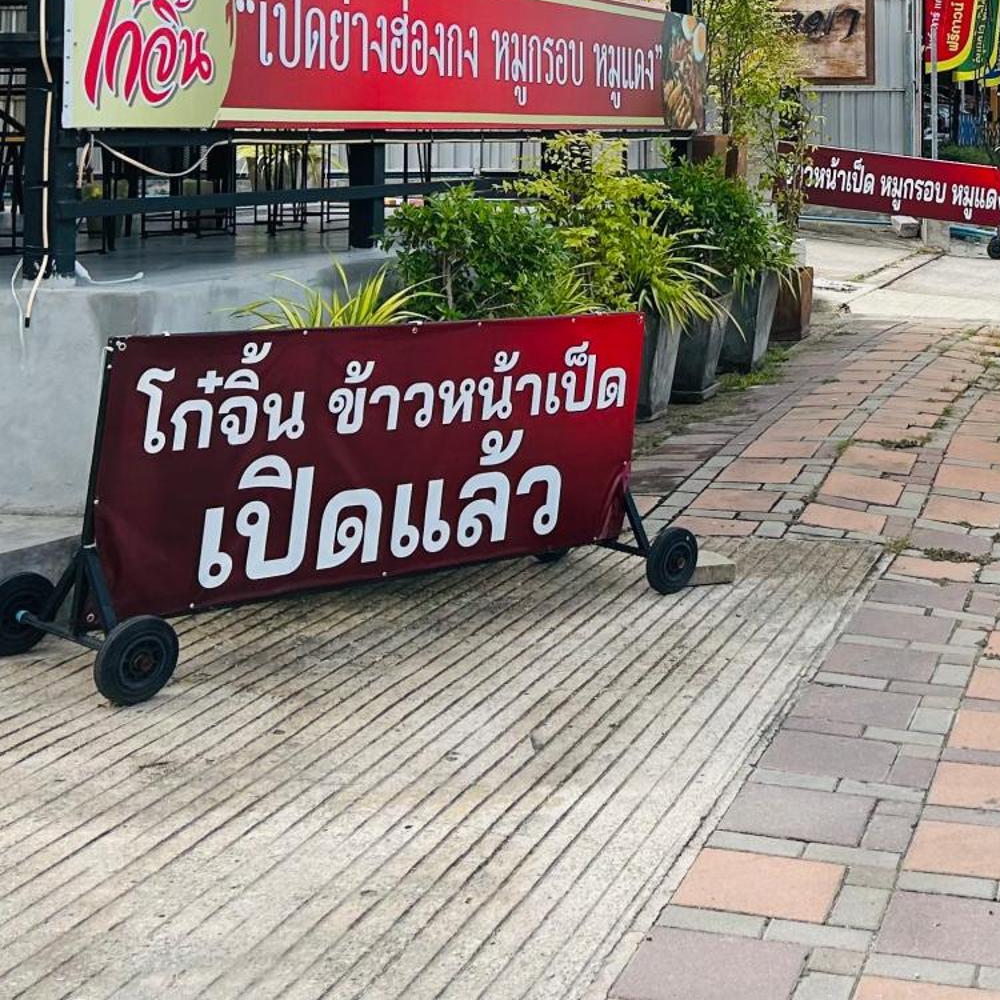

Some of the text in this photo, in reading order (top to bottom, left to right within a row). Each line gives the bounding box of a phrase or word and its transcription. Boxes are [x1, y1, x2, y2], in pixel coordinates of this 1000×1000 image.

[491, 28, 584, 106] หมูกรอบ
[593, 43, 663, 110] หมูแดง”
[880, 172, 947, 211] หมูกรอบ
[136, 340, 627, 455] โก๋จิ้น ข้าวหน้าเป็ด
[197, 428, 562, 589] เปิดแล้ว
